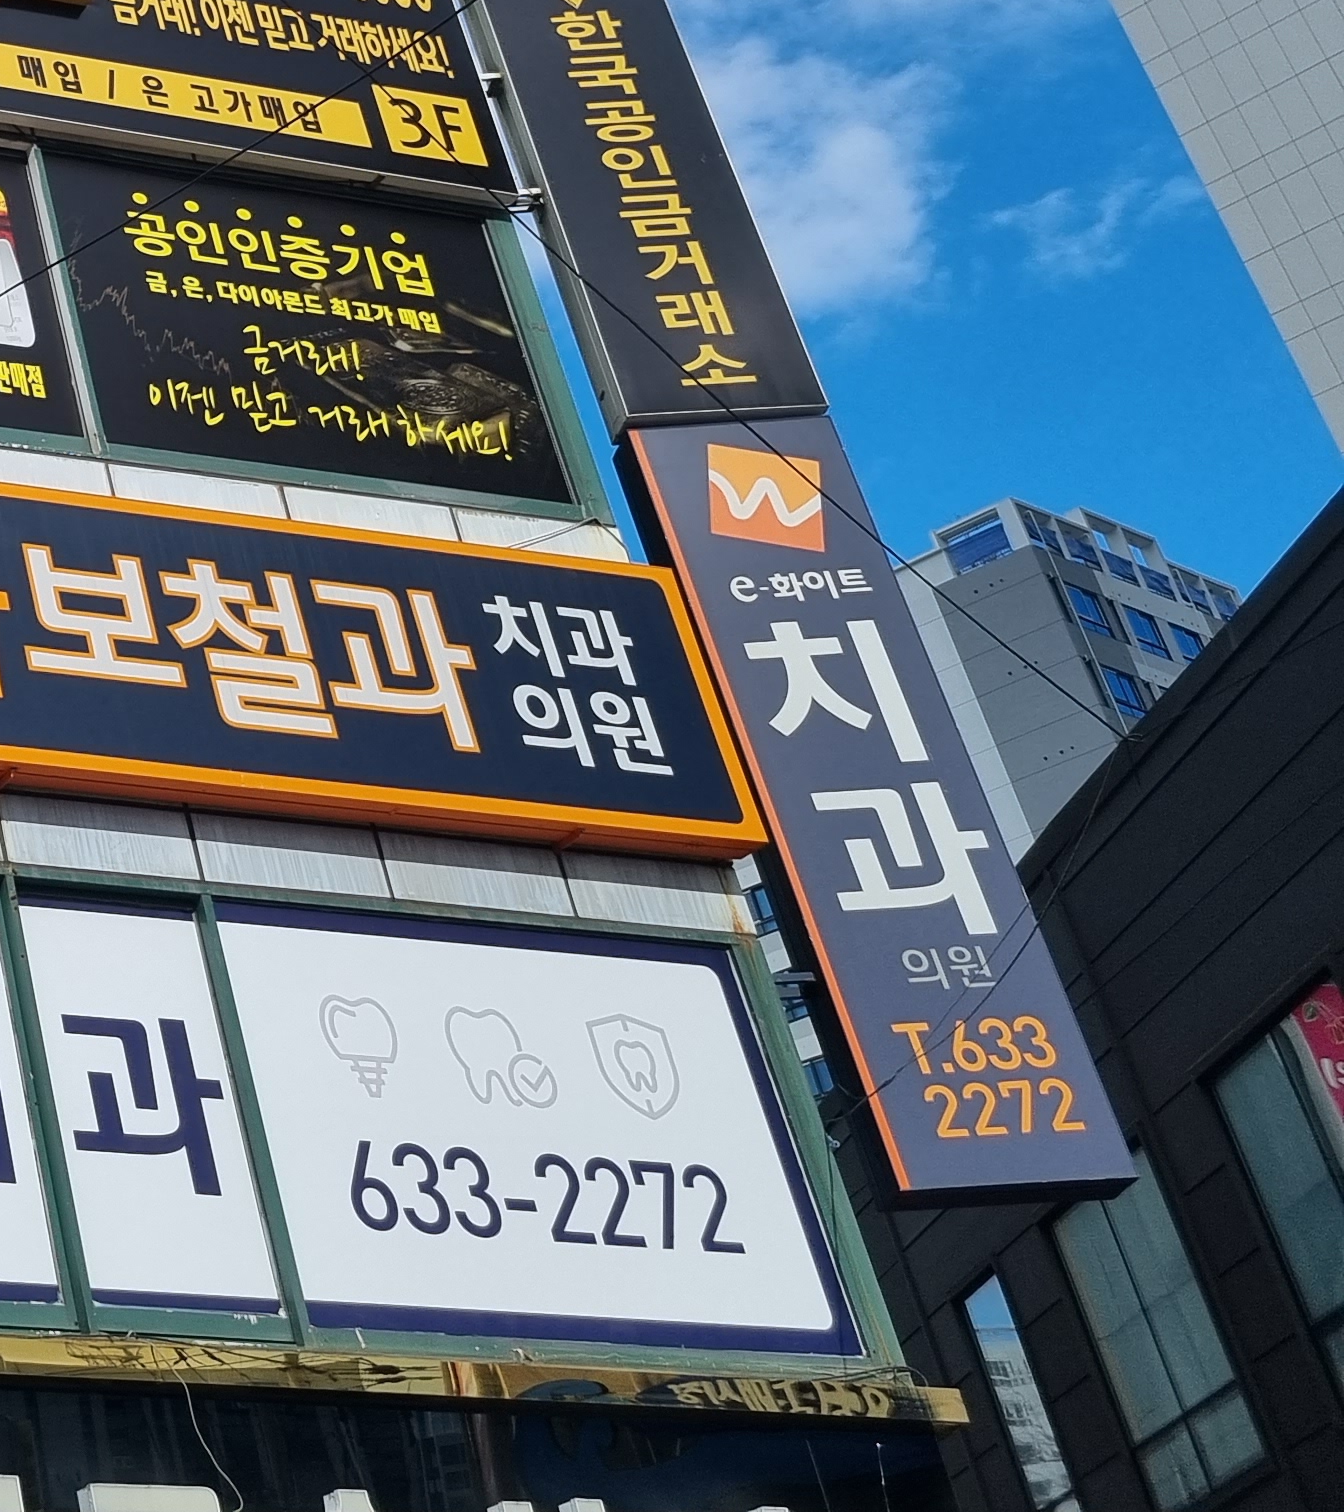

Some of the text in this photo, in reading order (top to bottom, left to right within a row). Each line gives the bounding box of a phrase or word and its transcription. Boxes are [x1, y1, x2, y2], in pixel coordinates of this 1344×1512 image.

[256, 3, 315, 52] 믿고
[311, 13, 455, 78] 거래하세요!
[16, 54, 84, 95] 매입
[141, 75, 170, 109] 은
[388, 96, 468, 153] 3F
[550, 9, 758, 388] 한국공인금거래소
[123, 210, 435, 297] 공인인증기업
[216, 281, 326, 316] 다이아몬드
[330, 297, 395, 327] 최고가
[397, 307, 442, 334] 매입
[242, 324, 365, 381] 금거래!
[148, 378, 224, 426] 이젠
[231, 385, 298, 432] 믿고
[729, 567, 874, 602] e-화이트
[482, 594, 636, 688] 치과
[513, 683, 674, 778] 의원
[743, 618, 1000, 937] 치과
[901, 945, 998, 990] 의원
[891, 1015, 1058, 1076] T.633
[924, 1078, 1088, 1139] 2272
[349, 1139, 746, 1255] 633-2272
